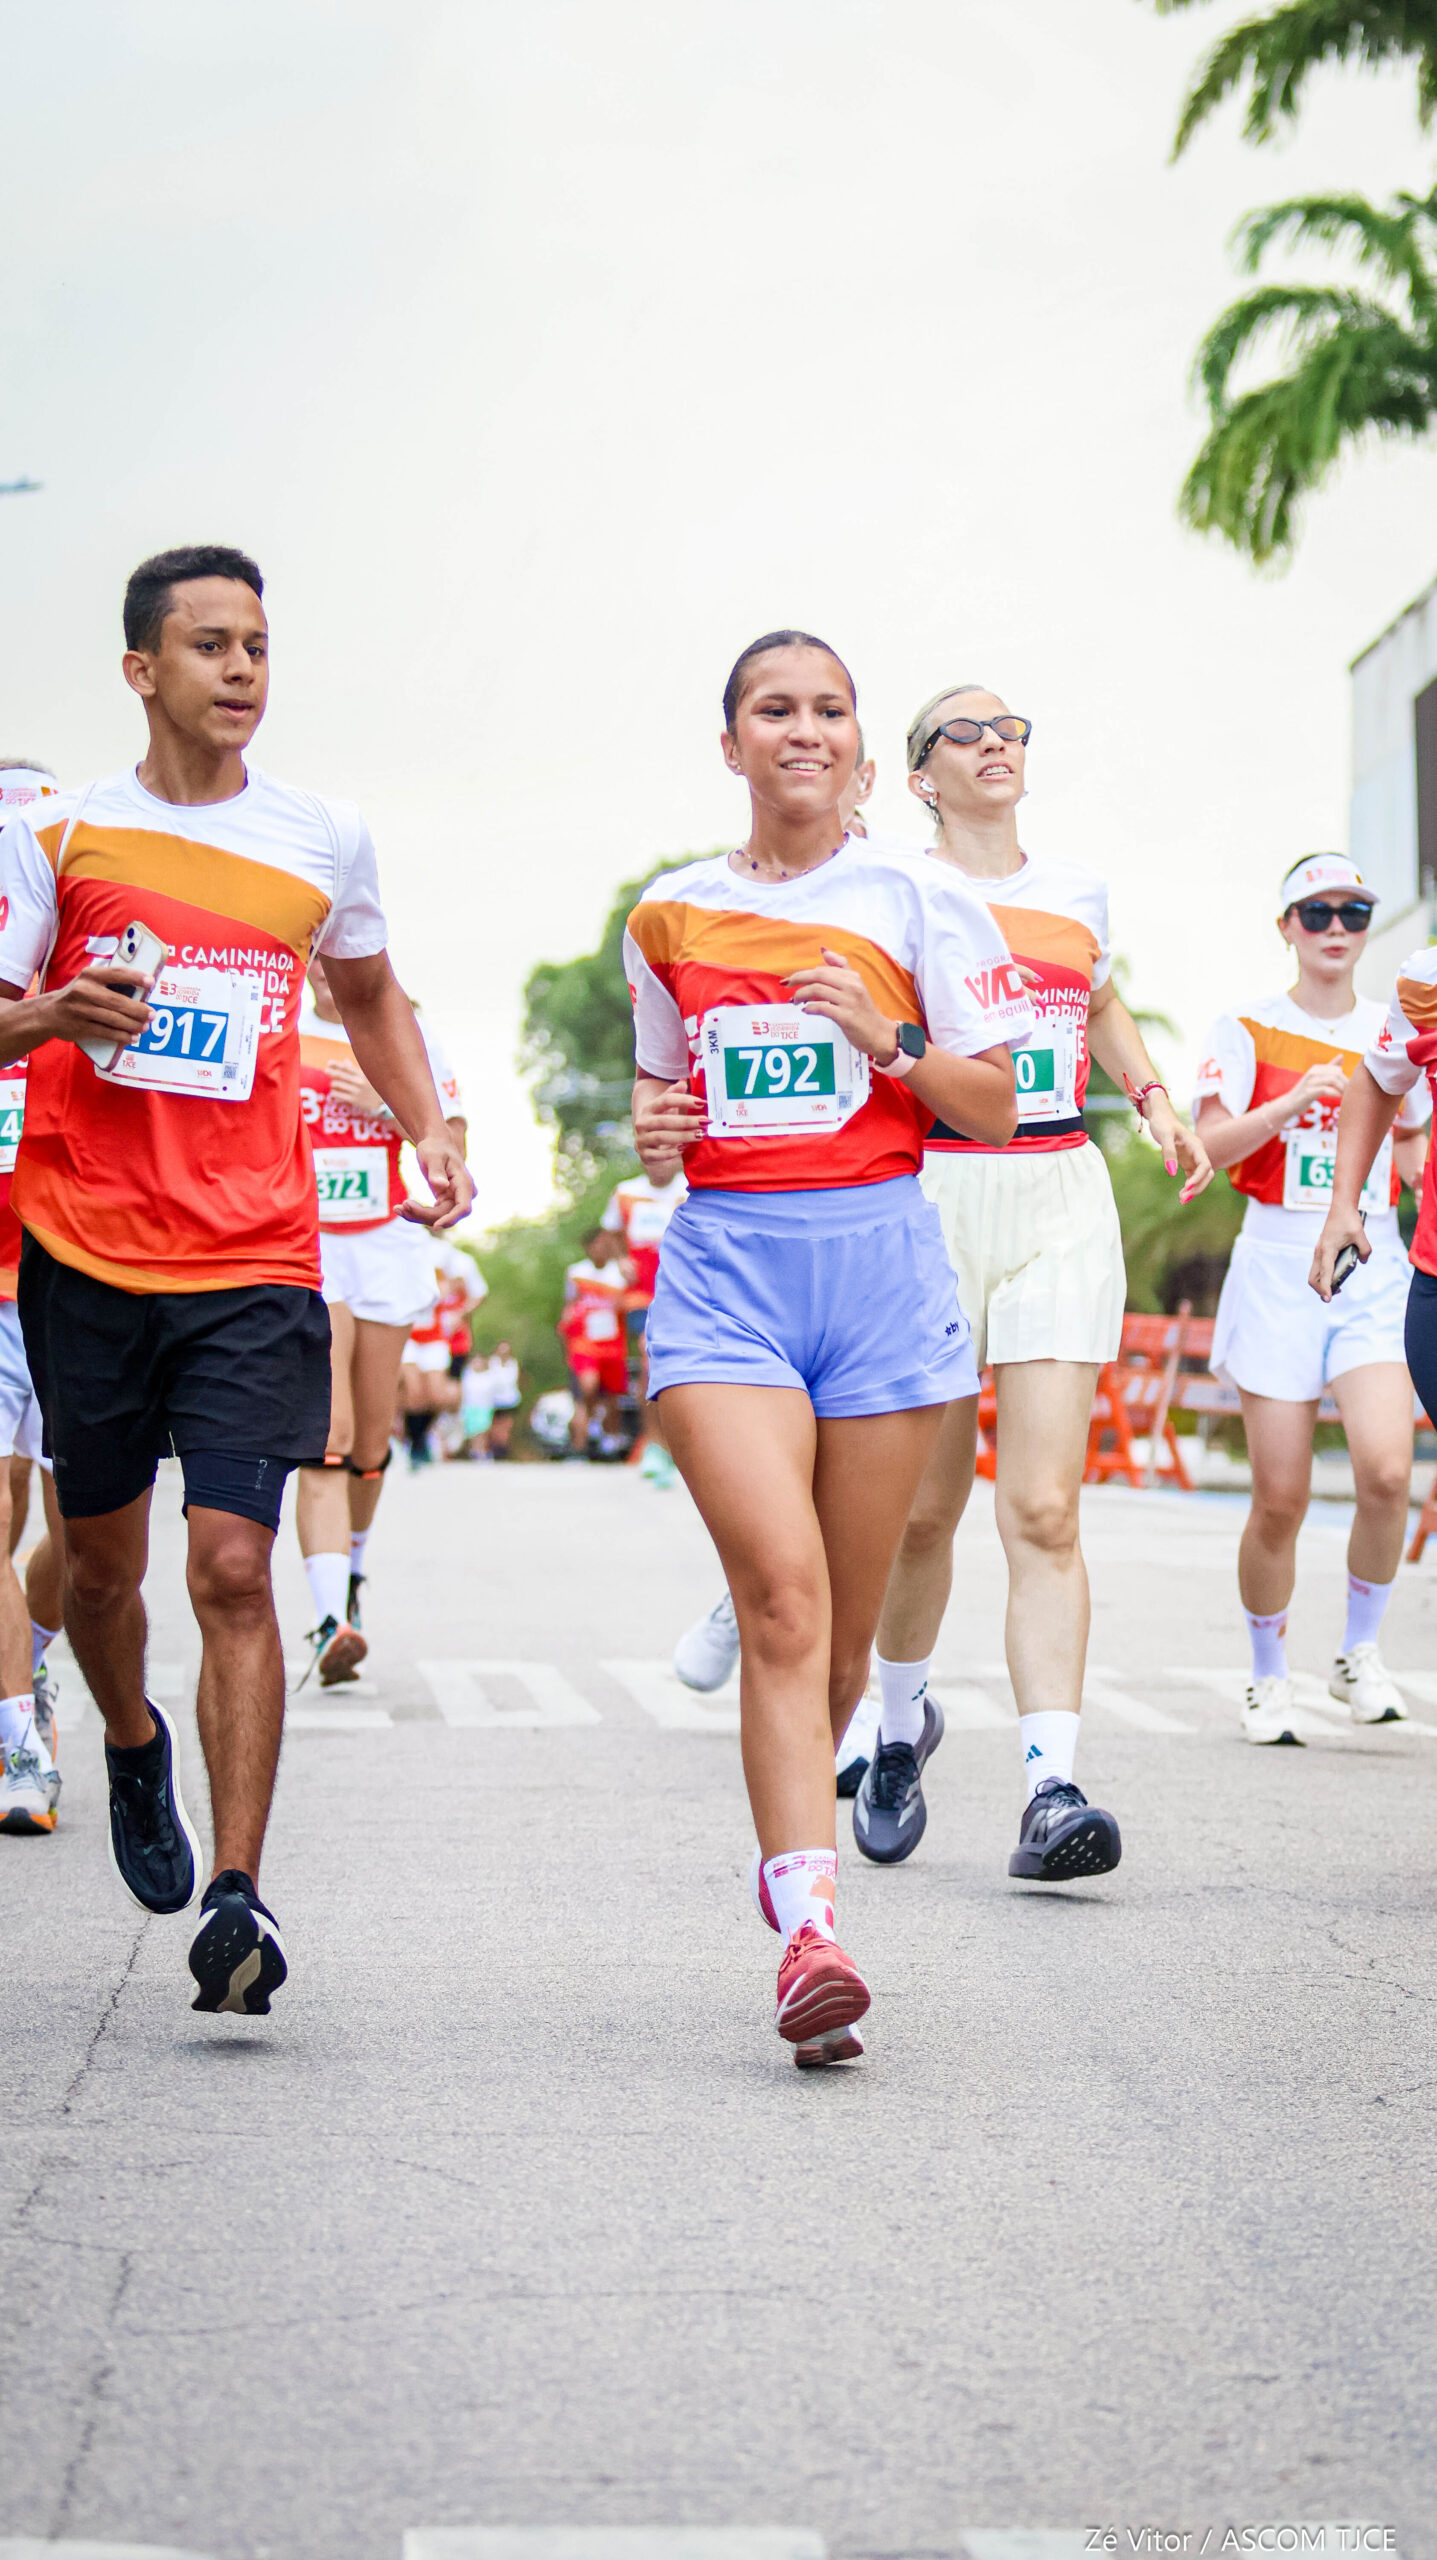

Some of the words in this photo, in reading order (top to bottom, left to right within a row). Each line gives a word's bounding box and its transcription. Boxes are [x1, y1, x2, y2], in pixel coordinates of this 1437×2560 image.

[181, 945, 294, 972] CAMINHADA
[131, 1008, 228, 1059] 917
[707, 1029, 720, 1055] 3KM
[738, 1046, 820, 1095] 792
[316, 1171, 362, 1200] 372
